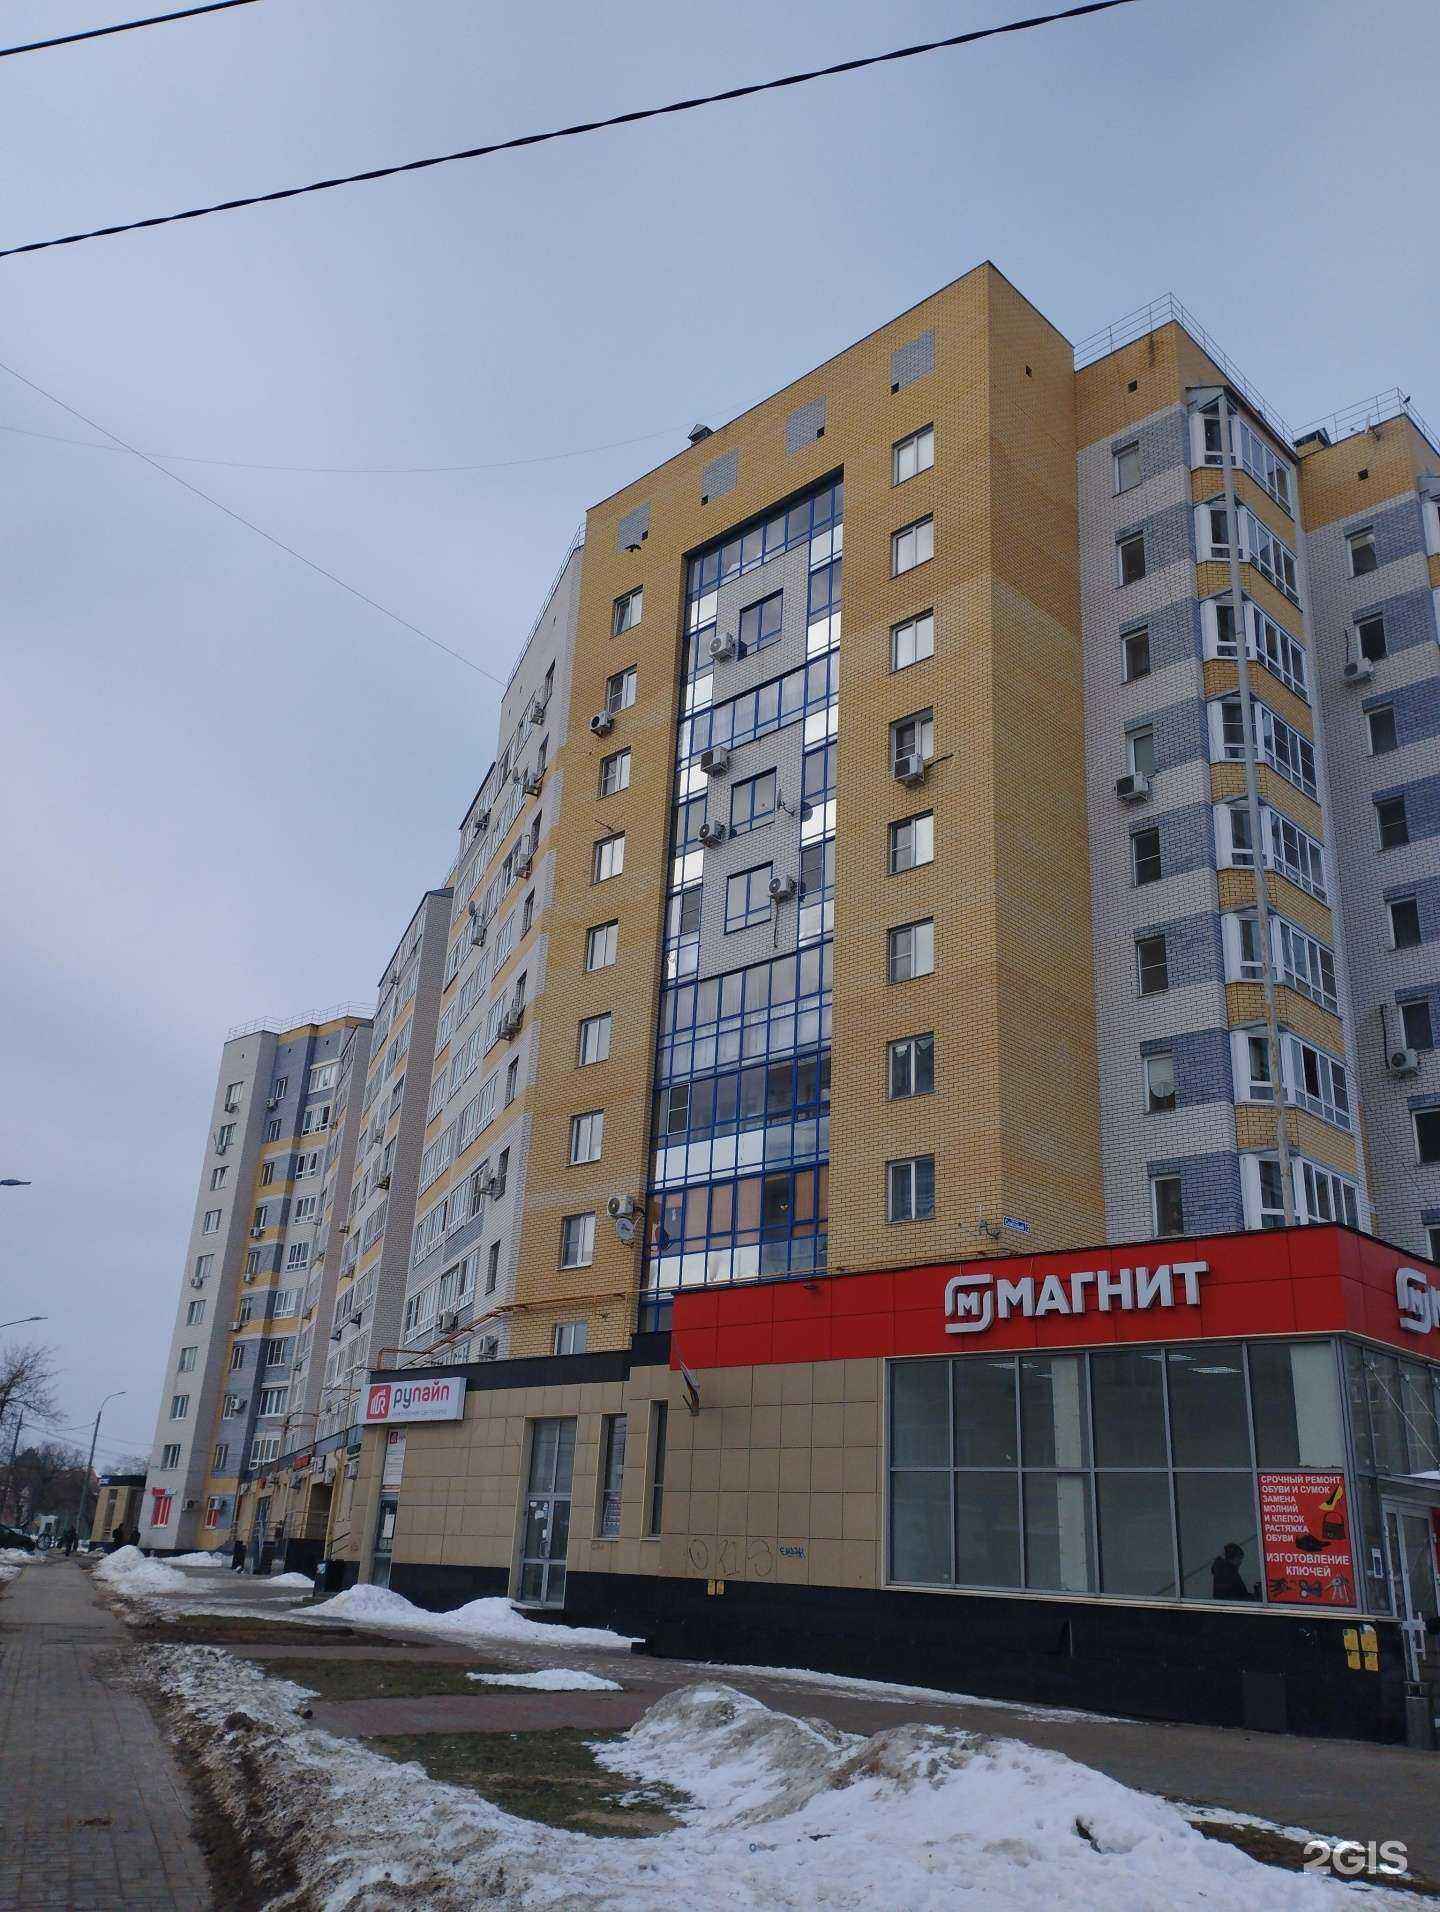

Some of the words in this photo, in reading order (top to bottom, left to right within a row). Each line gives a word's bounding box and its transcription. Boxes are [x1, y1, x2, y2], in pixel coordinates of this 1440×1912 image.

[997, 1261, 1209, 1319] МАГНИТ
[1261, 1475, 1304, 1483] СРОЧНЫЙ
[1306, 1476, 1341, 1484] РЕМОНТ
[1301, 1486, 1330, 1494] СУМОК
[1263, 1504, 1299, 1513] МОЛНИЙ
[1264, 1515, 1270, 1523] И
[1265, 1524, 1309, 1532] РАСТЯЖКА
[1266, 1534, 1294, 1542] ОБУВИ
[1266, 1553, 1351, 1565] ИЗГОТОВЛЕНИЕ
[1286, 1566, 1331, 1577] КЛЮЧЕЙ
